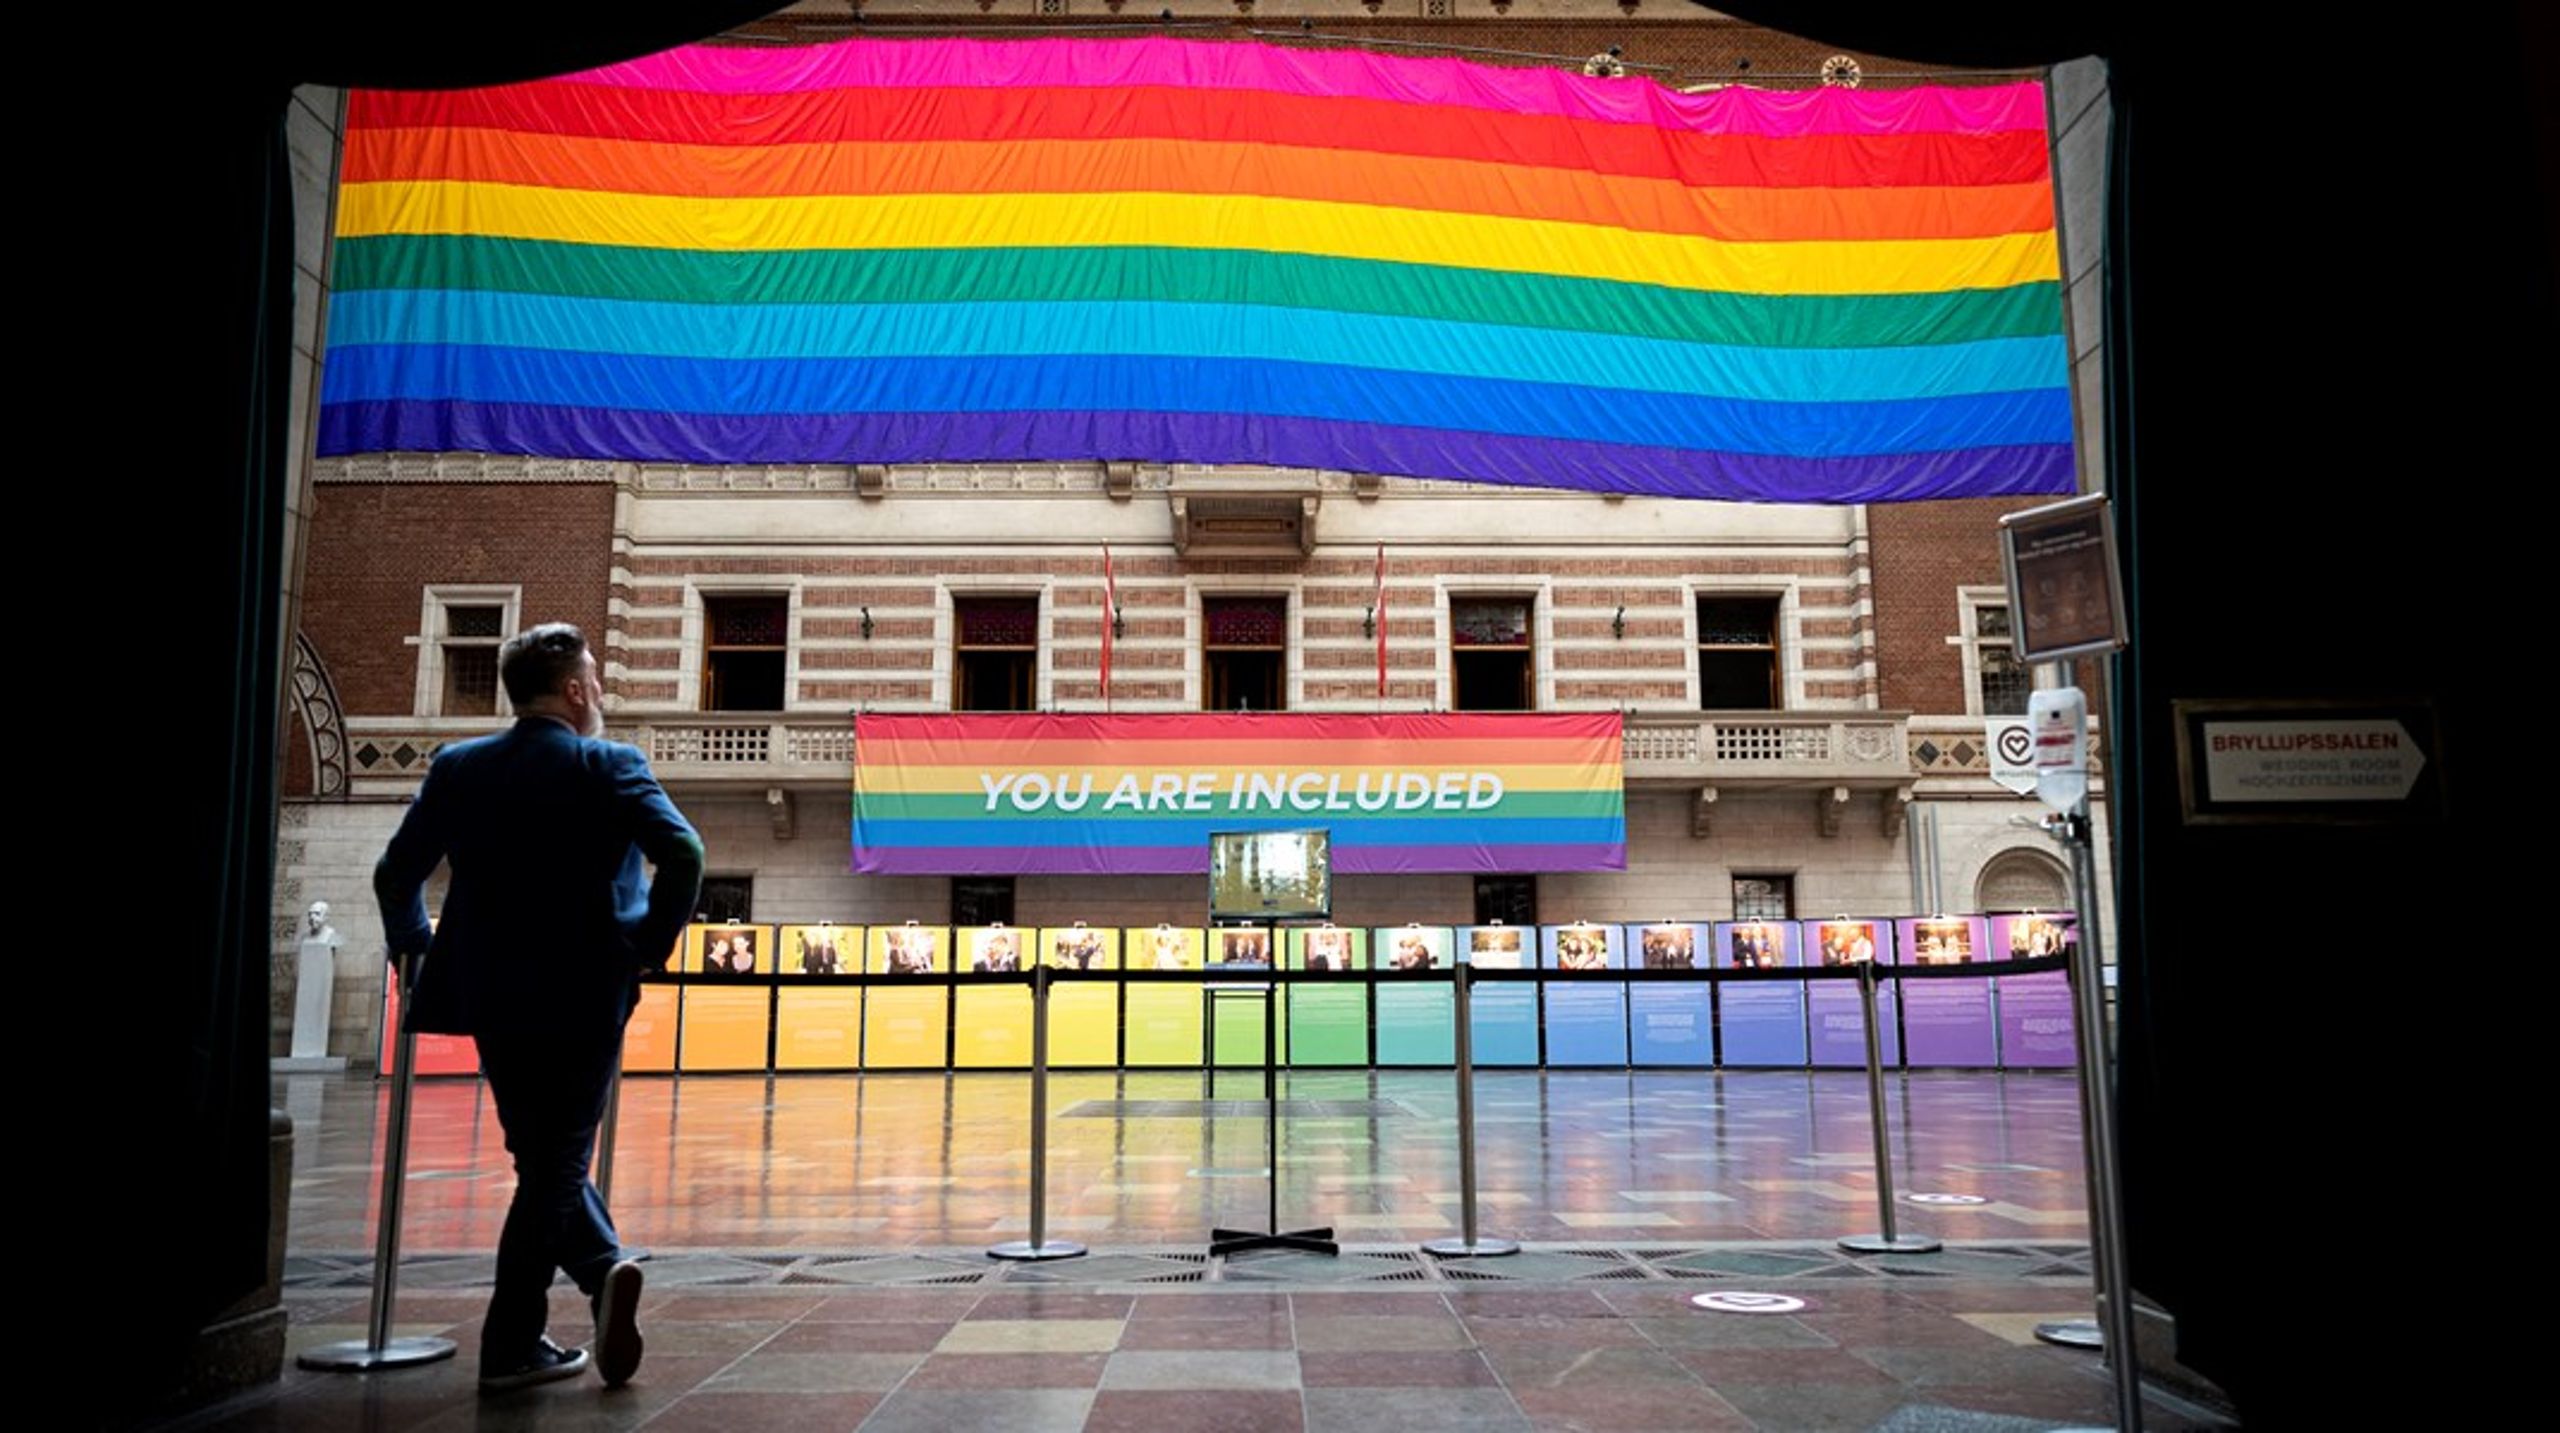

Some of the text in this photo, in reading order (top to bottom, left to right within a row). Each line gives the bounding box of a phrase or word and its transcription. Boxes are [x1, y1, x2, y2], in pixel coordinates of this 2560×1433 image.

[2212, 733, 2399, 752] BRYLLUPSSALEN
[2259, 757, 2401, 771] WEDDING ROOM
[2238, 774, 2403, 788] HOCHZEITSZIMMER
[978, 773, 1505, 812] YOU ARE INCLUDED
